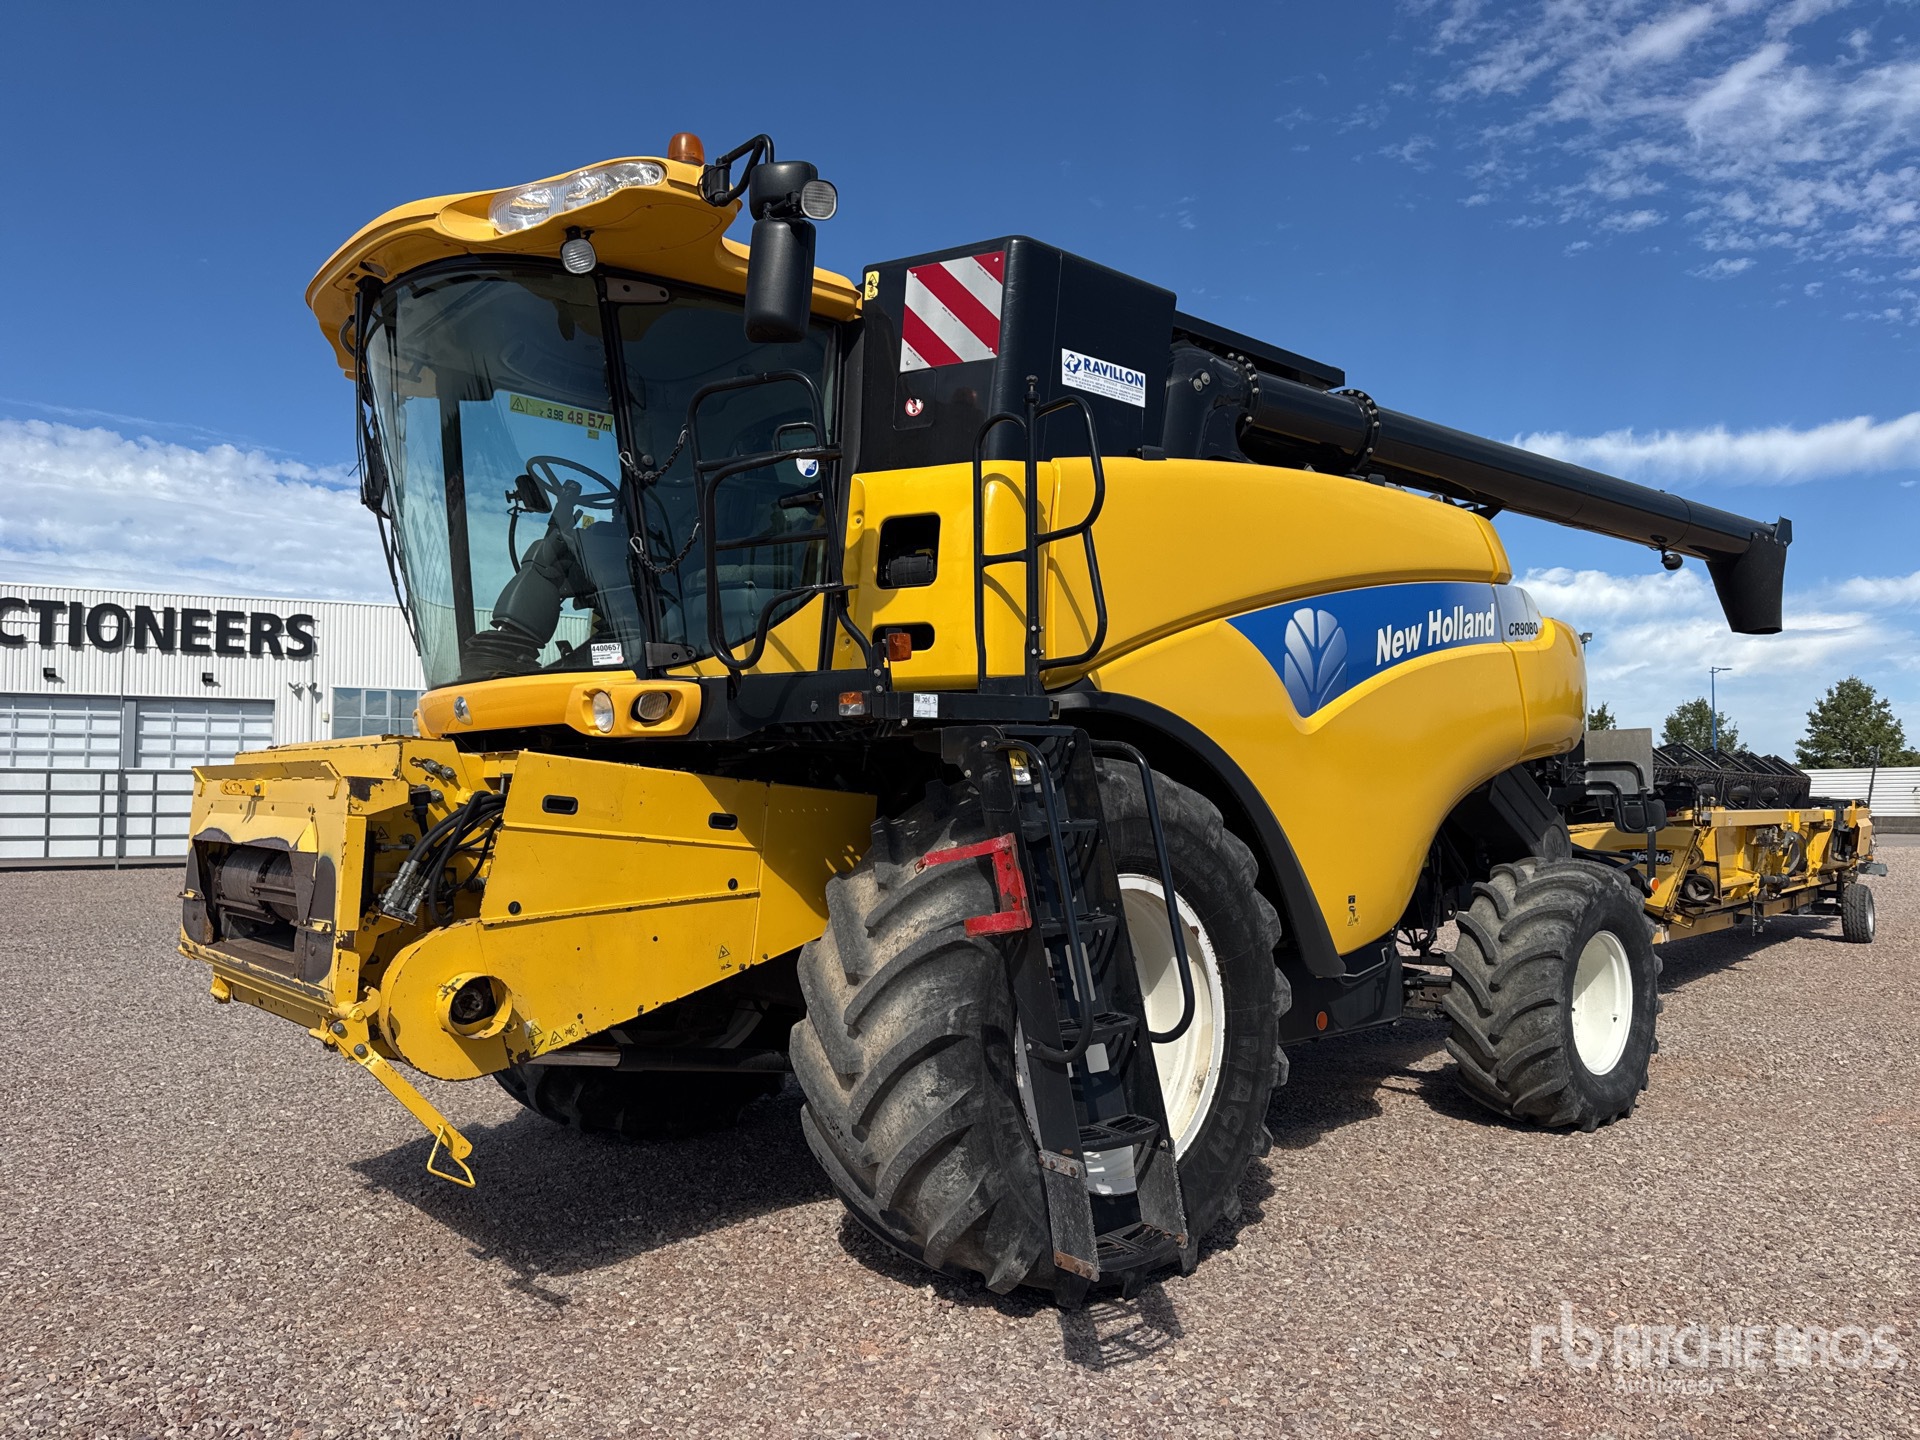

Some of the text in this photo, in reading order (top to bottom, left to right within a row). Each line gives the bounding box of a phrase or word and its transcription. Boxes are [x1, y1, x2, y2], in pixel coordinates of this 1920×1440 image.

[1083, 357, 1144, 388] RAVILLON
[546, 408, 611, 430] 3.98 4.8 5.7m
[0, 596, 315, 659] CTIONEERS
[1375, 603, 1495, 666] New Holland
[1509, 622, 1538, 636] CR9080
[592, 644, 621, 652] 4400657
